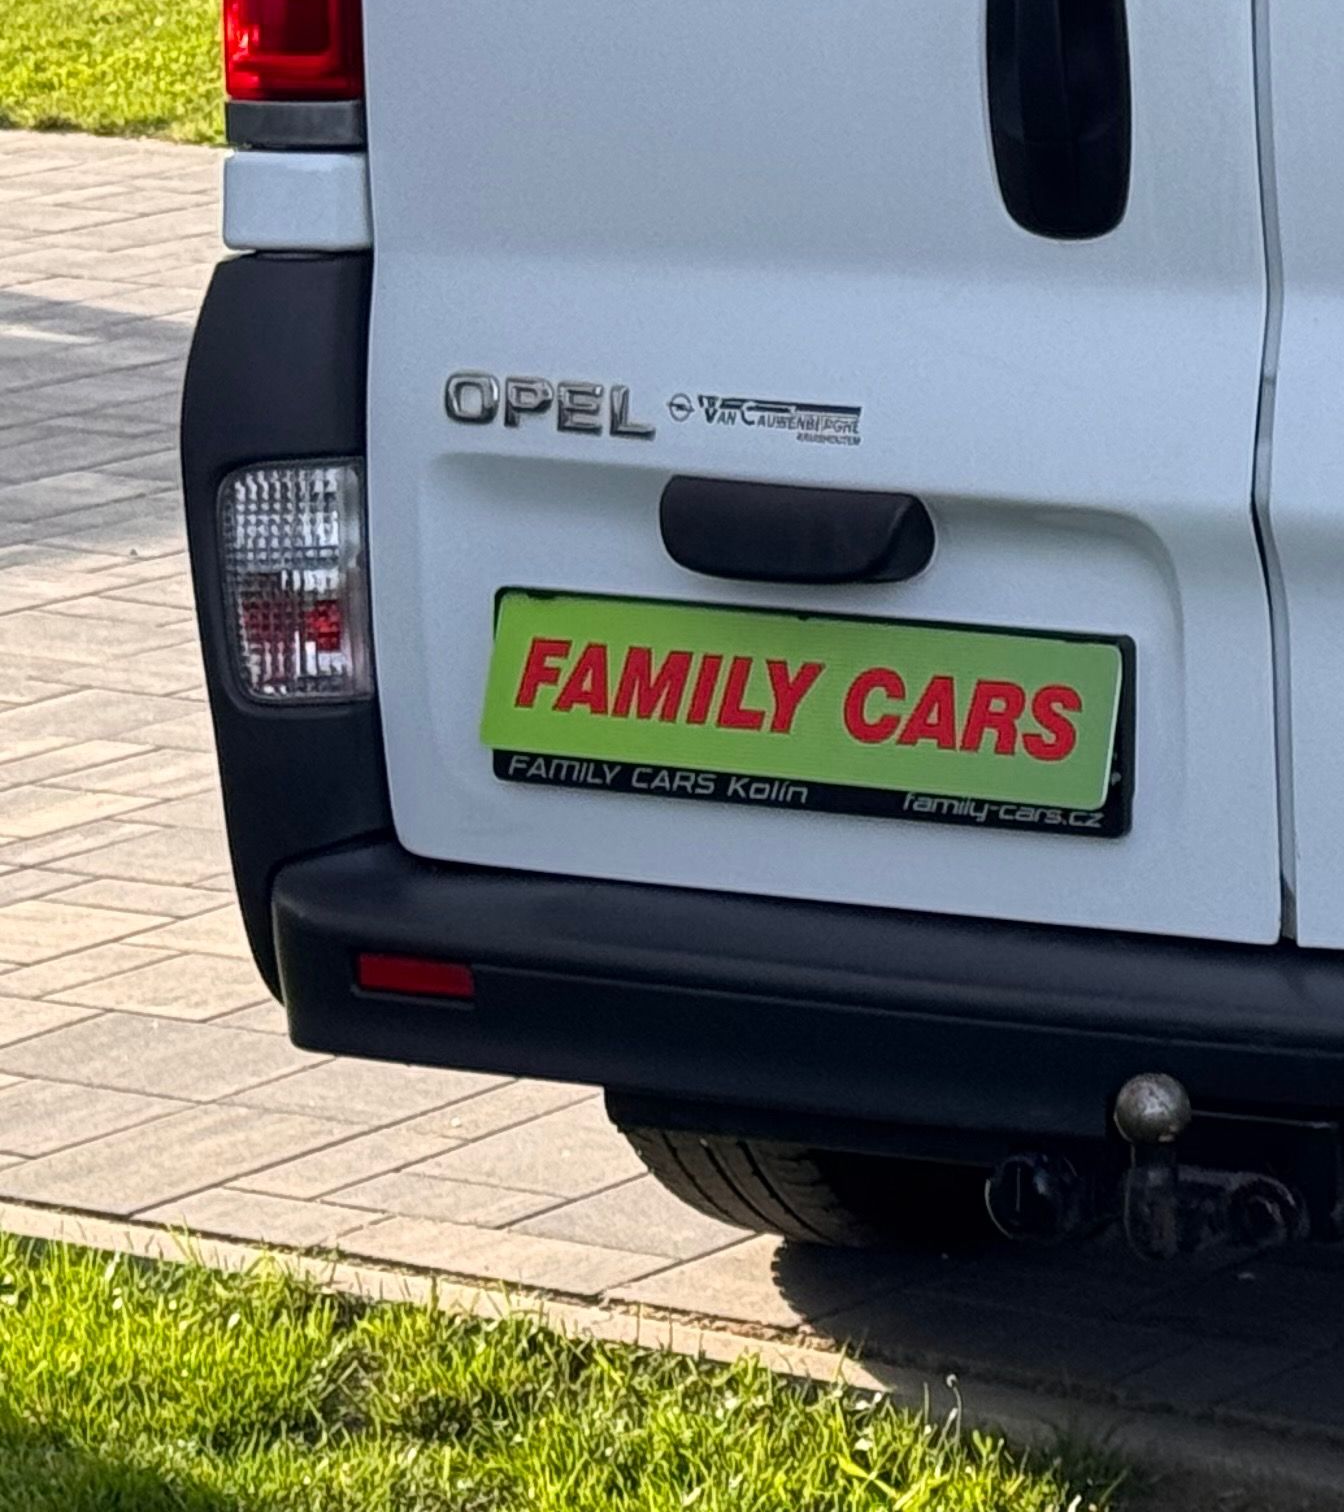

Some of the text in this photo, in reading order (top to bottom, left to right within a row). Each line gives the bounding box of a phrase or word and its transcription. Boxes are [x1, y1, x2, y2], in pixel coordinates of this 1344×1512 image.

[445, 370, 656, 441] OPEL
[703, 396, 737, 426] VAN
[514, 637, 1083, 762] FAMILY CARS
[508, 754, 622, 785] FAMILY
[631, 766, 717, 795] CARS
[902, 791, 1105, 829] family-cars.cz
